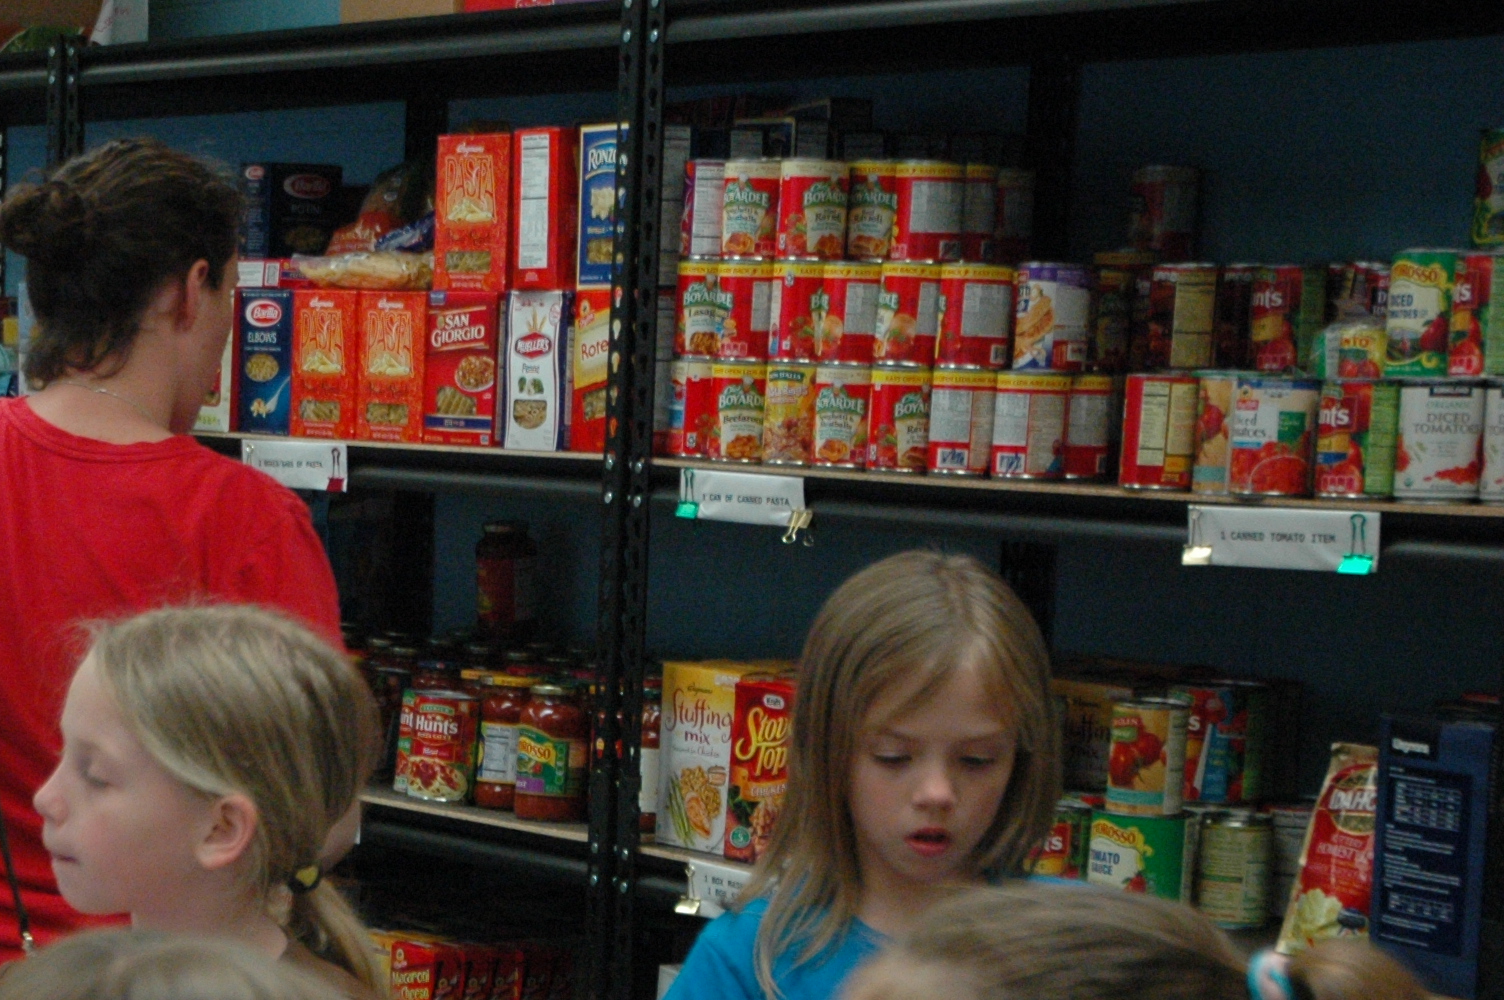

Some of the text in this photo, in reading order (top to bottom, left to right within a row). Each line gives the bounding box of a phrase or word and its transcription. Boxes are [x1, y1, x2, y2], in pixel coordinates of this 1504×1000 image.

[444, 313, 471, 330] SAN
[247, 331, 278, 344] ELBOWS
[430, 324, 486, 348] GIORGIO
[719, 393, 765, 408] BOYARD
[1426, 411, 1471, 425] DICED
[709, 493, 722, 503] CAN
[724, 494, 734, 503] OF
[736, 494, 764, 506] CANNED
[765, 496, 791, 507] PASTA
[1230, 531, 1265, 543] CANNED
[1269, 532, 1306, 543] TOMATO
[1310, 532, 1337, 544] ITEM
[415, 715, 458, 735] Hunt's
[683, 730, 711, 746] mix
[754, 743, 788, 777] Top
